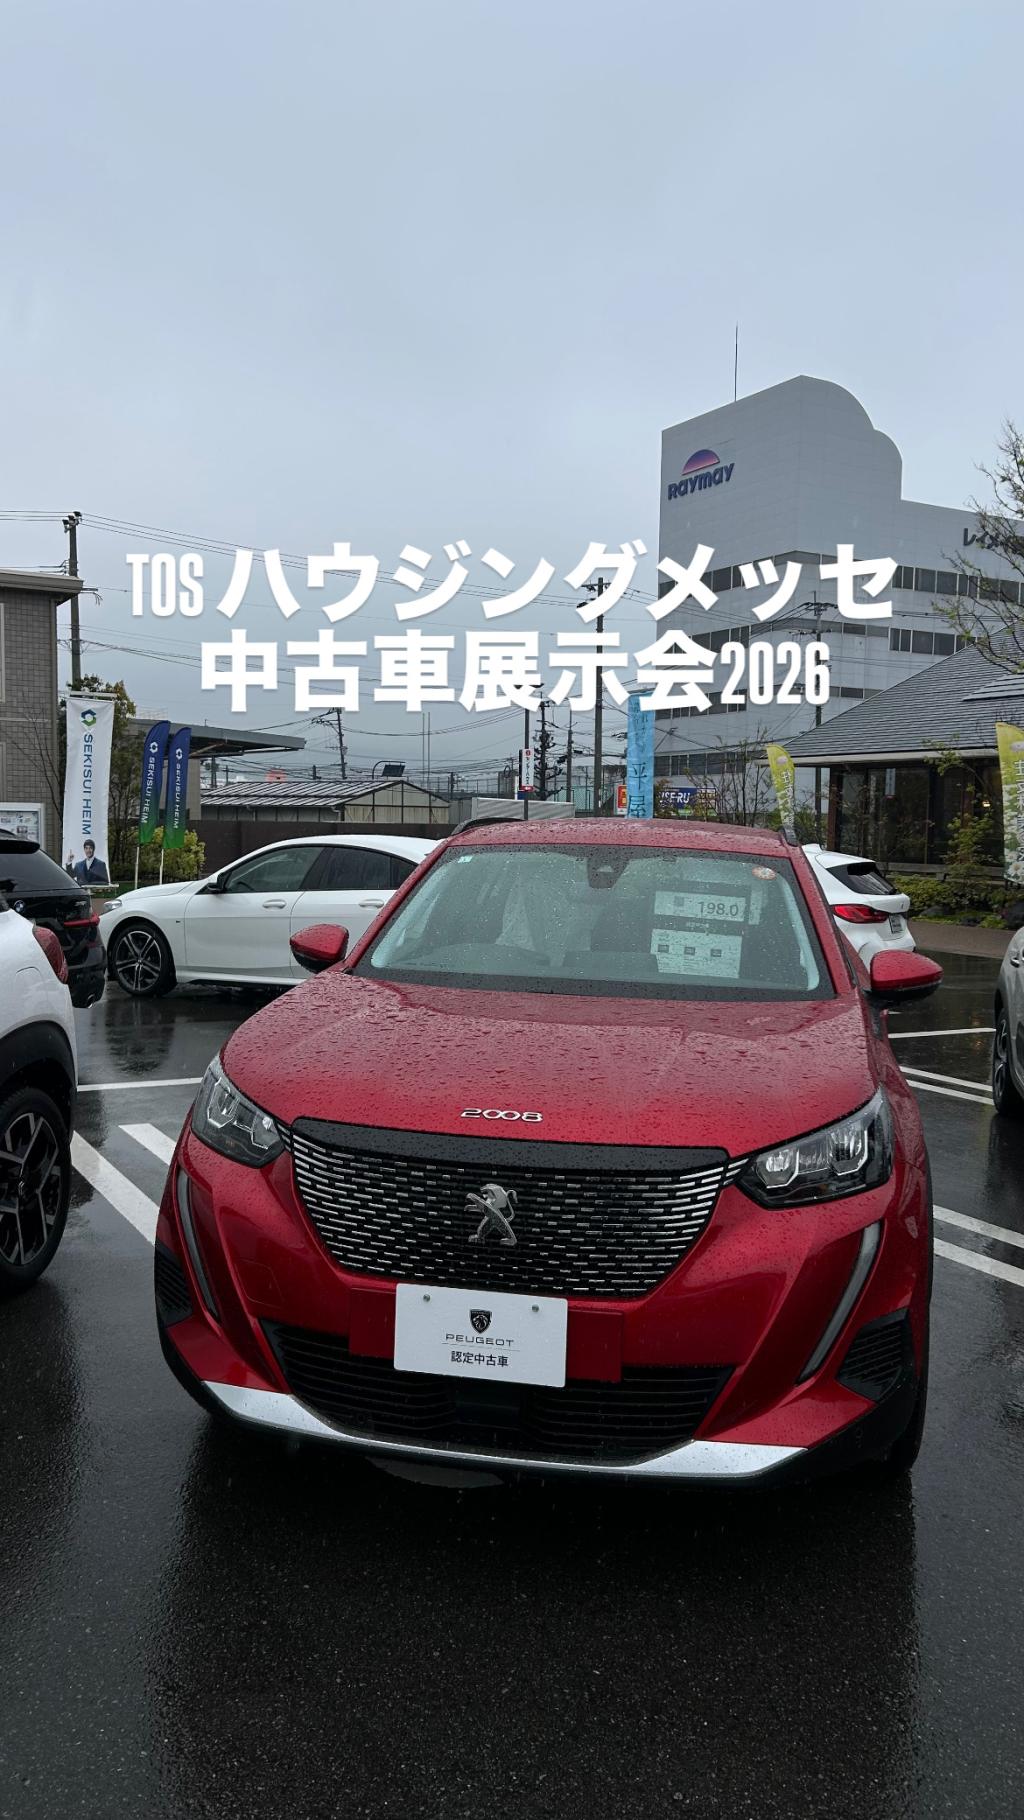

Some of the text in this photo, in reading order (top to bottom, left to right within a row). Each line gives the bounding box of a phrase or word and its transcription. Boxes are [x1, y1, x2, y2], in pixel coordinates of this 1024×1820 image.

[81, 734, 93, 835] SEKISUI HEIM
[141, 757, 156, 824] SEKISUI HEIM
[175, 763, 183, 802] SEKISUI
[697, 901, 739, 917] 198.0
[460, 1107, 543, 1122] 2008
[445, 1333, 515, 1347] PEUGEOT
[450, 1350, 509, 1367] 認定中古車
